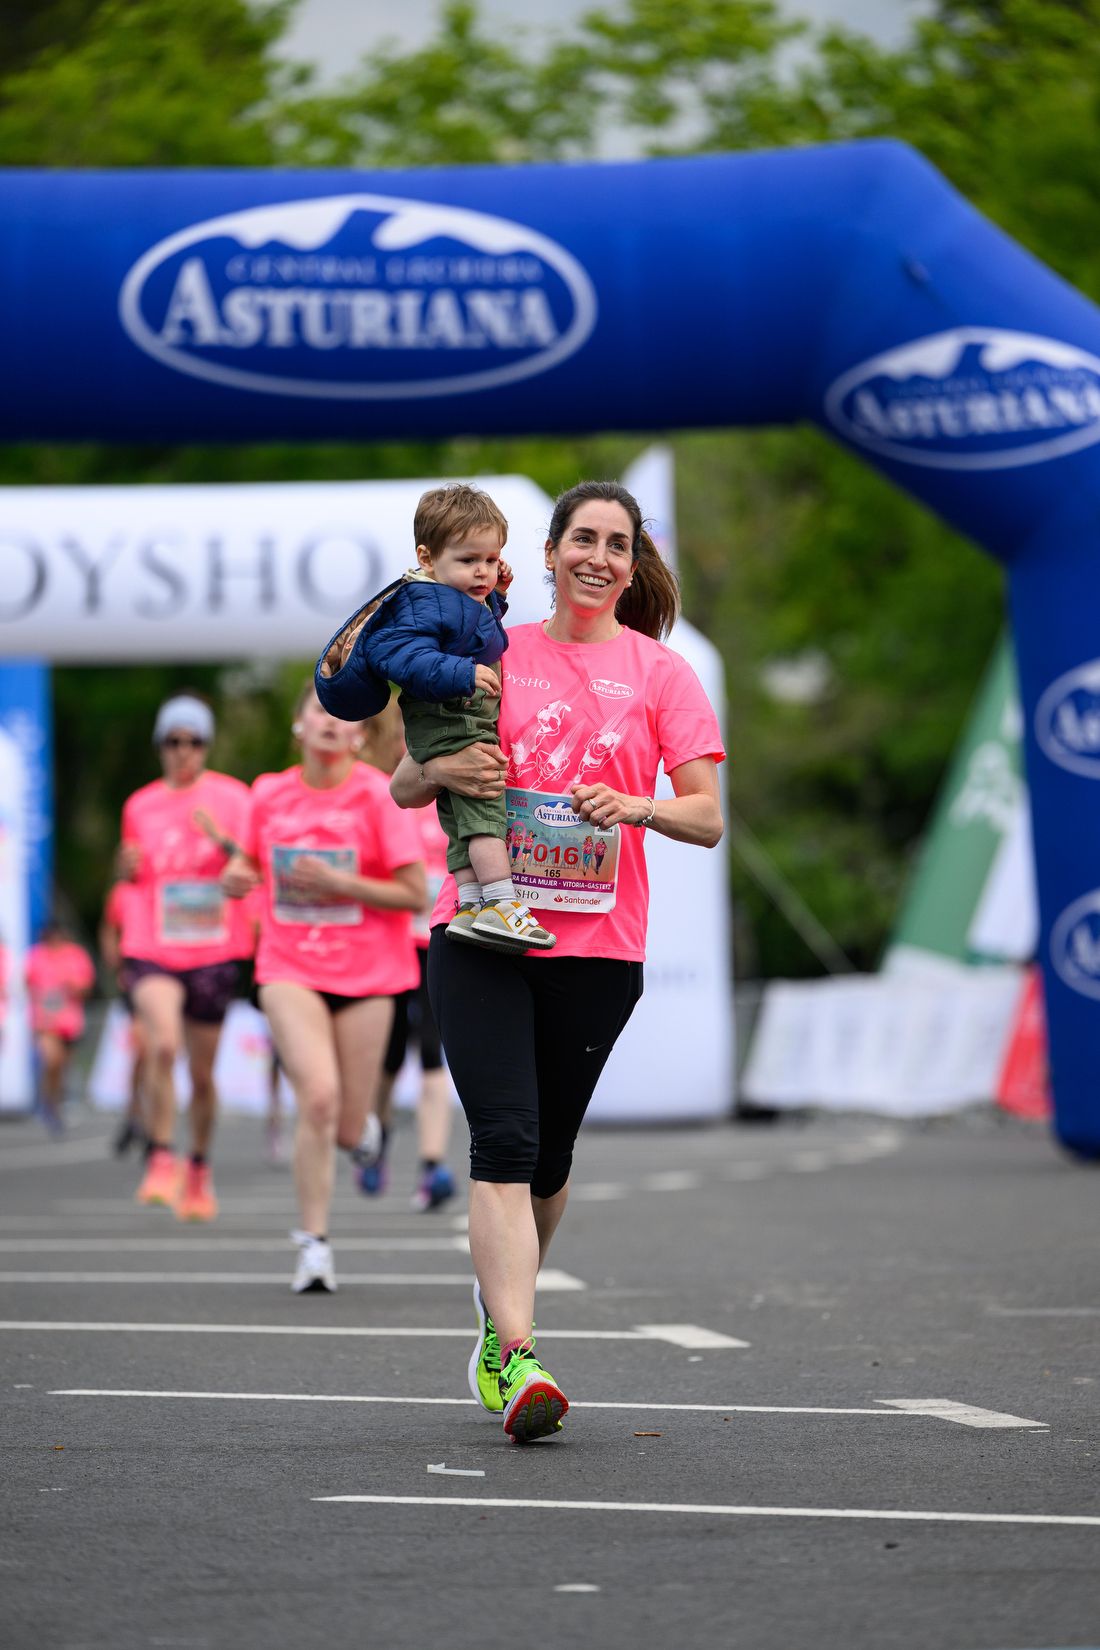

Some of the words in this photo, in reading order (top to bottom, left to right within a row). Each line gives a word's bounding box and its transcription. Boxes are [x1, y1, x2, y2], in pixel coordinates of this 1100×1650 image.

[160, 256, 560, 349] ASTURIANA
[592, 682, 630, 696] ASTURIANA
[533, 843, 579, 865] 016
[544, 869, 561, 878] 165
[538, 878, 558, 887] MUJER
[562, 881, 612, 890] VITORIA-GASTEIZ
[514, 888, 540, 901] SHO
[564, 896, 601, 905] Santander
